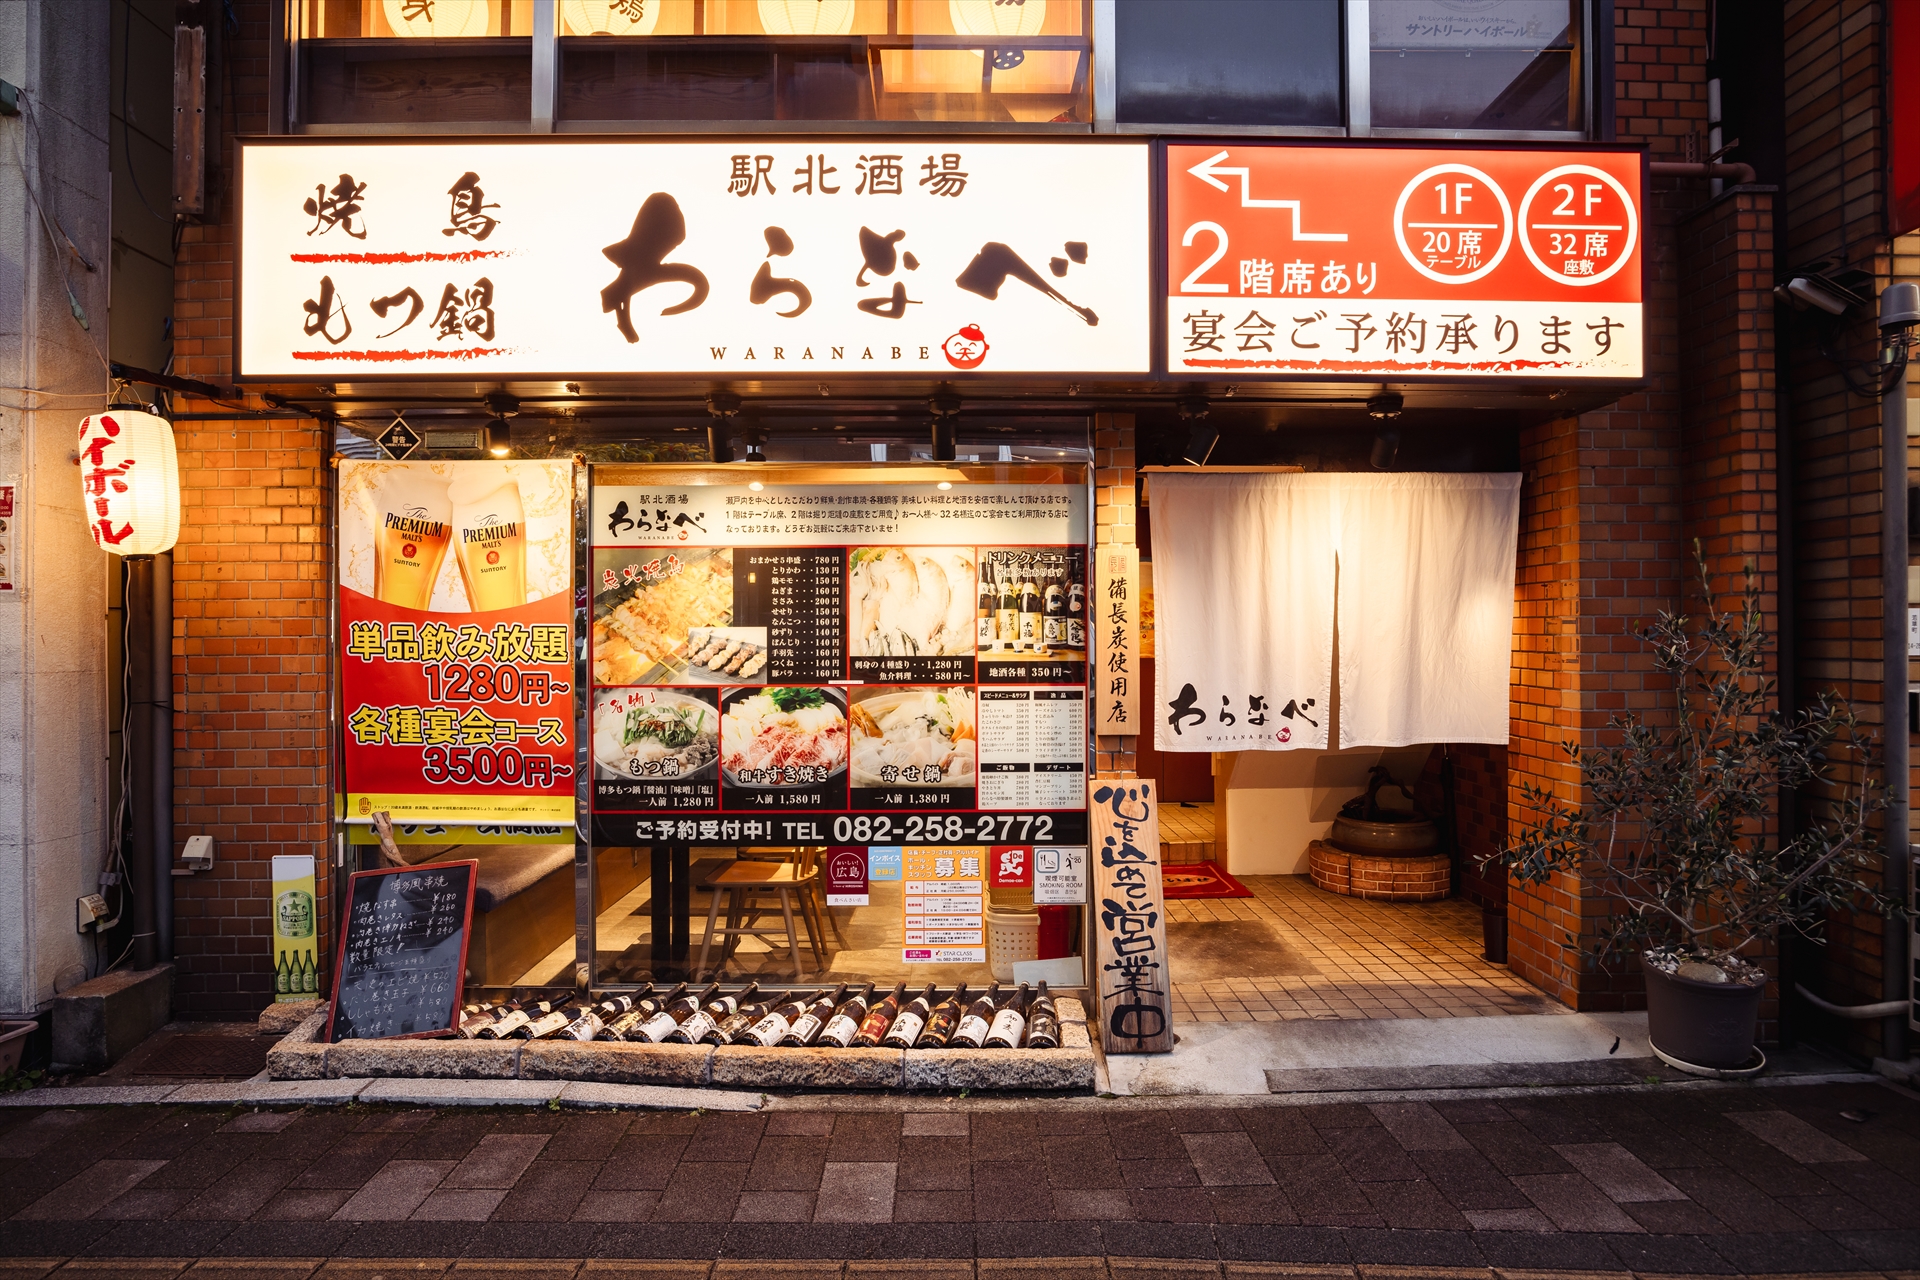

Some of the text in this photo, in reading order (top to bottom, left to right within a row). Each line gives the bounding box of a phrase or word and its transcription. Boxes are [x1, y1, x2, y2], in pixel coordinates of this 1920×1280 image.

[1405, 23, 1528, 38] サントリーハイボール
[727, 153, 969, 198] 駅北酒場
[1434, 182, 1473, 215] 1F
[1551, 183, 1603, 217] 2F
[1422, 229, 1483, 256] 20席
[1549, 232, 1609, 258] 32席
[600, 191, 1099, 344] わらなべ
[1426, 255, 1481, 270] テーブル
[1563, 258, 1595, 276] 座敷
[303, 275, 496, 345] もつ鍋
[1182, 309, 1626, 356] 宴会ご予約承ります
[710, 345, 930, 361] WARANABE
[79, 415, 137, 548] ハイボール
[639, 494, 689, 504] 駅北酒場
[385, 512, 444, 538] PREMIUM
[608, 500, 708, 538] わらなべ
[462, 522, 518, 544] PREMIUM
[393, 558, 421, 568] SUNTORY
[987, 551, 1078, 566] ドリンクメニュー
[480, 565, 507, 574] SUNTORY
[772, 566, 801, 575] とりかわ
[772, 586, 793, 596] ねぎま
[772, 597, 794, 606] ささみ
[772, 607, 793, 616] せせり
[772, 618, 801, 626] なんこつ
[349, 621, 570, 664] 単品飲み放題
[1107, 578, 1129, 723] 備長炭使用店
[772, 648, 794, 658] 手羽先
[772, 658, 794, 668] つくね
[989, 668, 1026, 678] 地酒各種
[1168, 683, 1319, 736] わらなべ
[349, 705, 567, 747] 各種宴会コース
[630, 758, 680, 776] もつ鍋
[739, 764, 829, 784] 和牛すき焼き
[881, 764, 942, 783] 寄せ鍋
[639, 797, 667, 807] 一人前
[745, 794, 774, 805] 一人前
[874, 794, 903, 804] 一人前
[782, 822, 824, 840] TEL
[833, 815, 1053, 843] 082-258-2772
[869, 854, 901, 862] インボイス
[836, 866, 860, 878] 広島
[934, 857, 980, 878] 募集
[1093, 784, 1166, 1049] 心を込めて営業中
